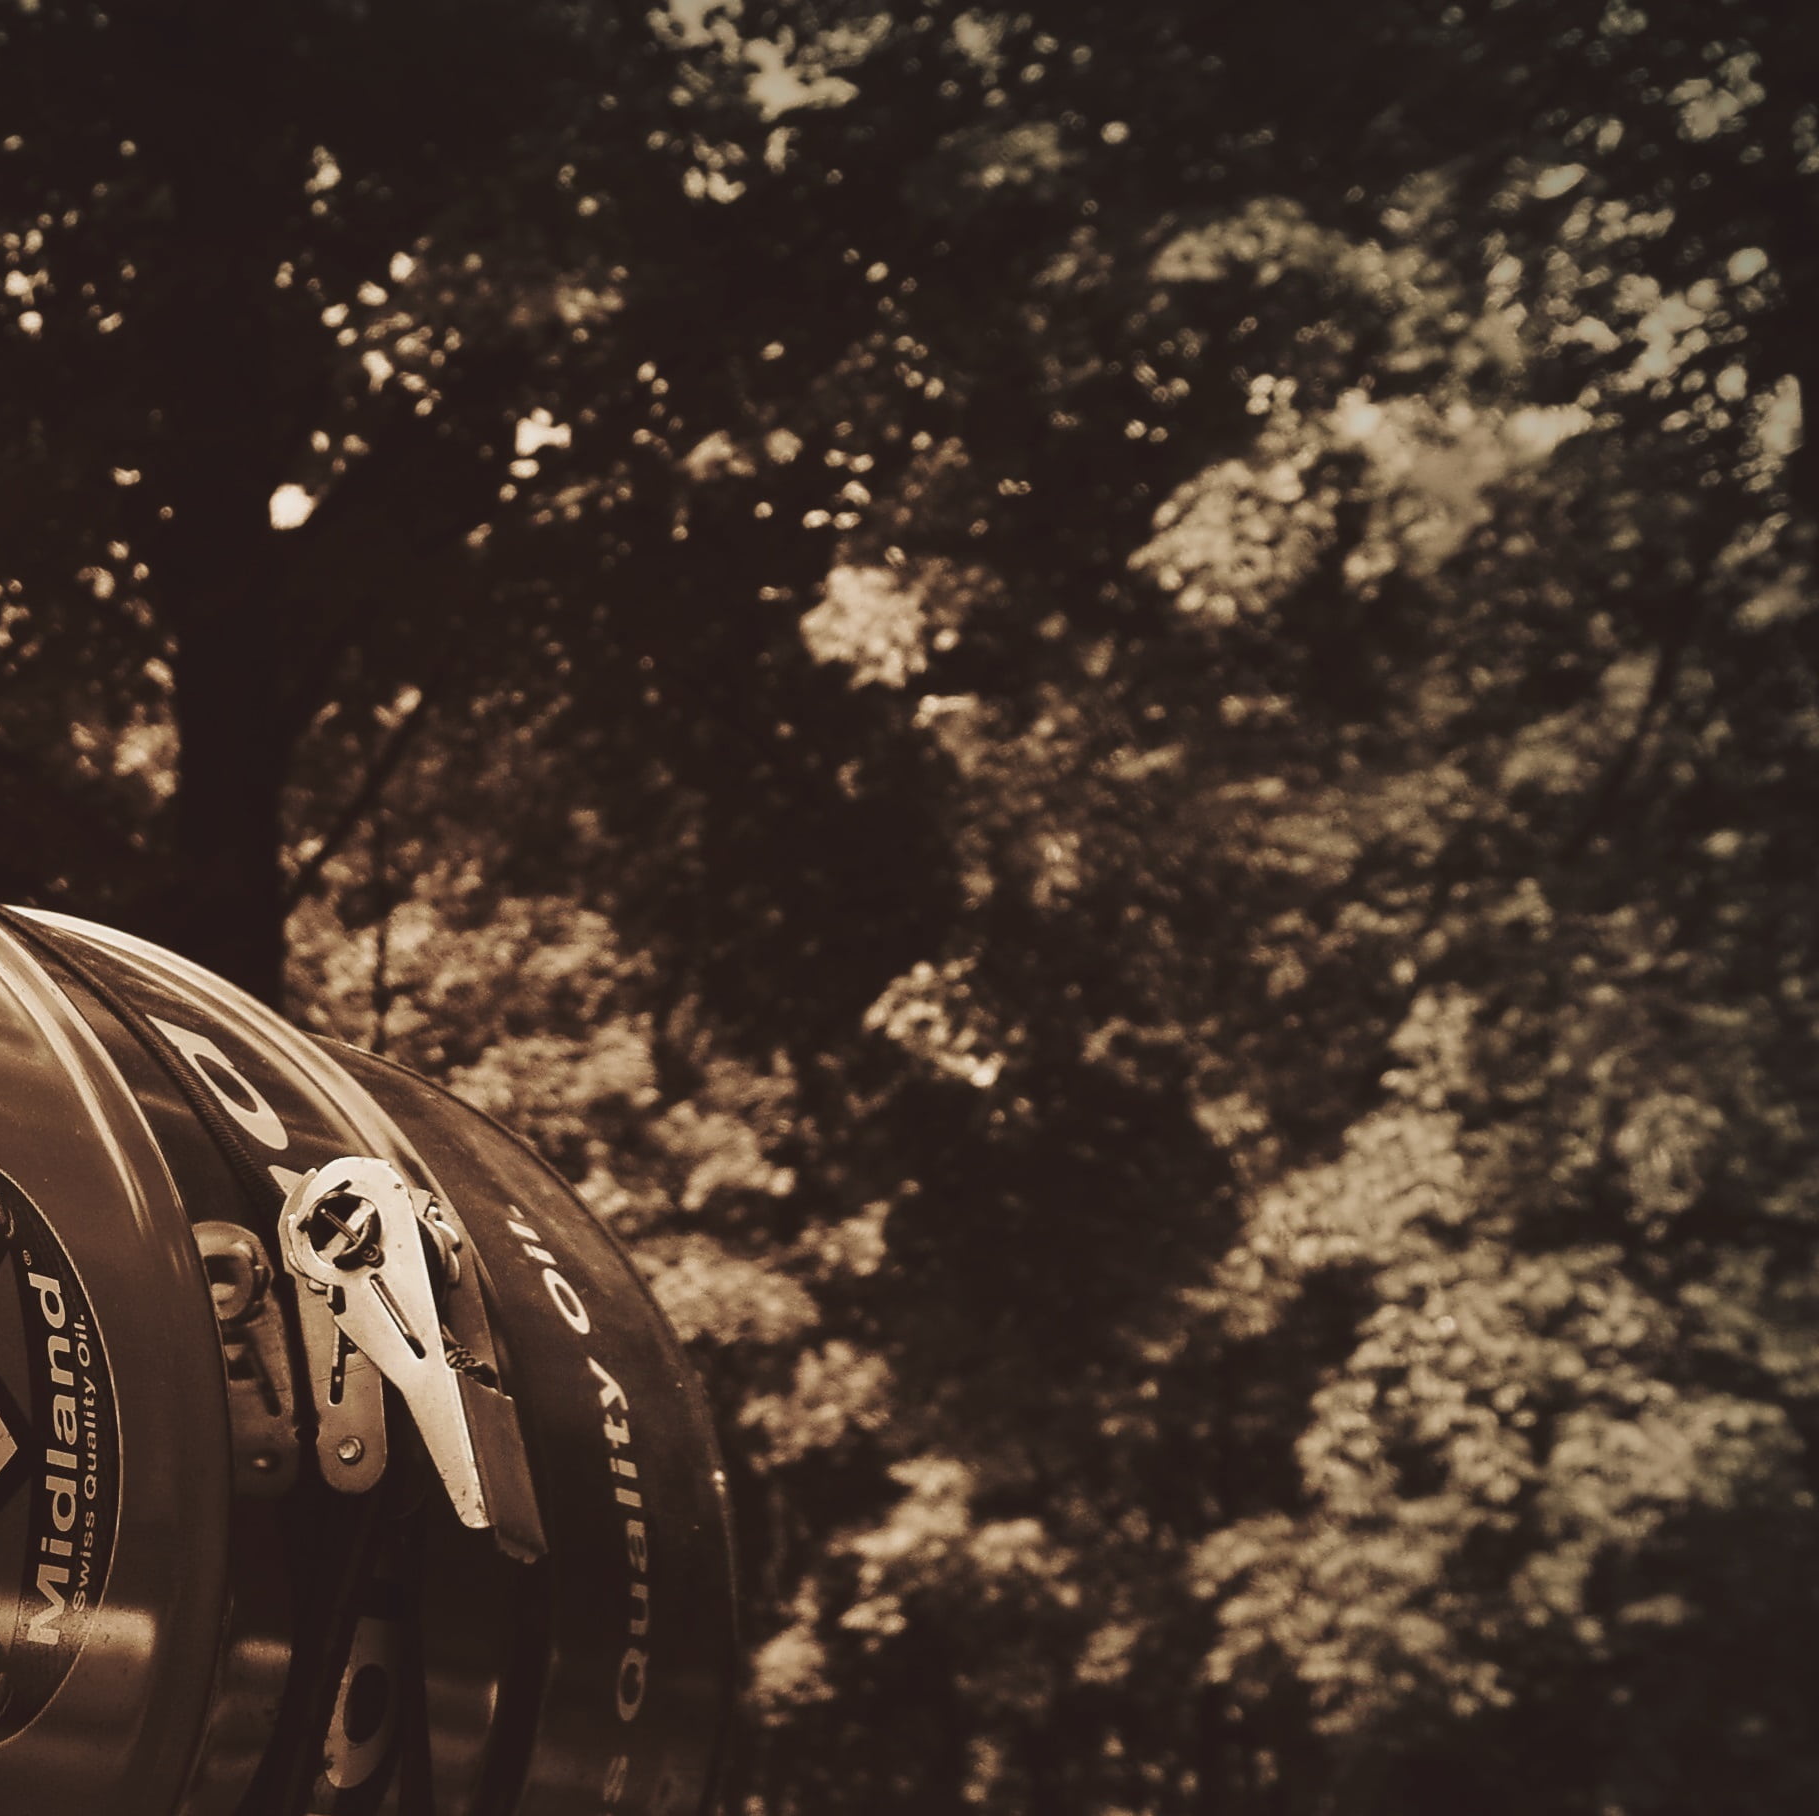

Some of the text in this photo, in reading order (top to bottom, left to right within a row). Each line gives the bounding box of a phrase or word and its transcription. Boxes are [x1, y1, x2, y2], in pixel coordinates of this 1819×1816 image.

[27, 1272, 78, 1645] Midland
[72, 1315, 98, 1612] Swiss Quality Oil.
[587, 1356, 649, 1722] Quality
